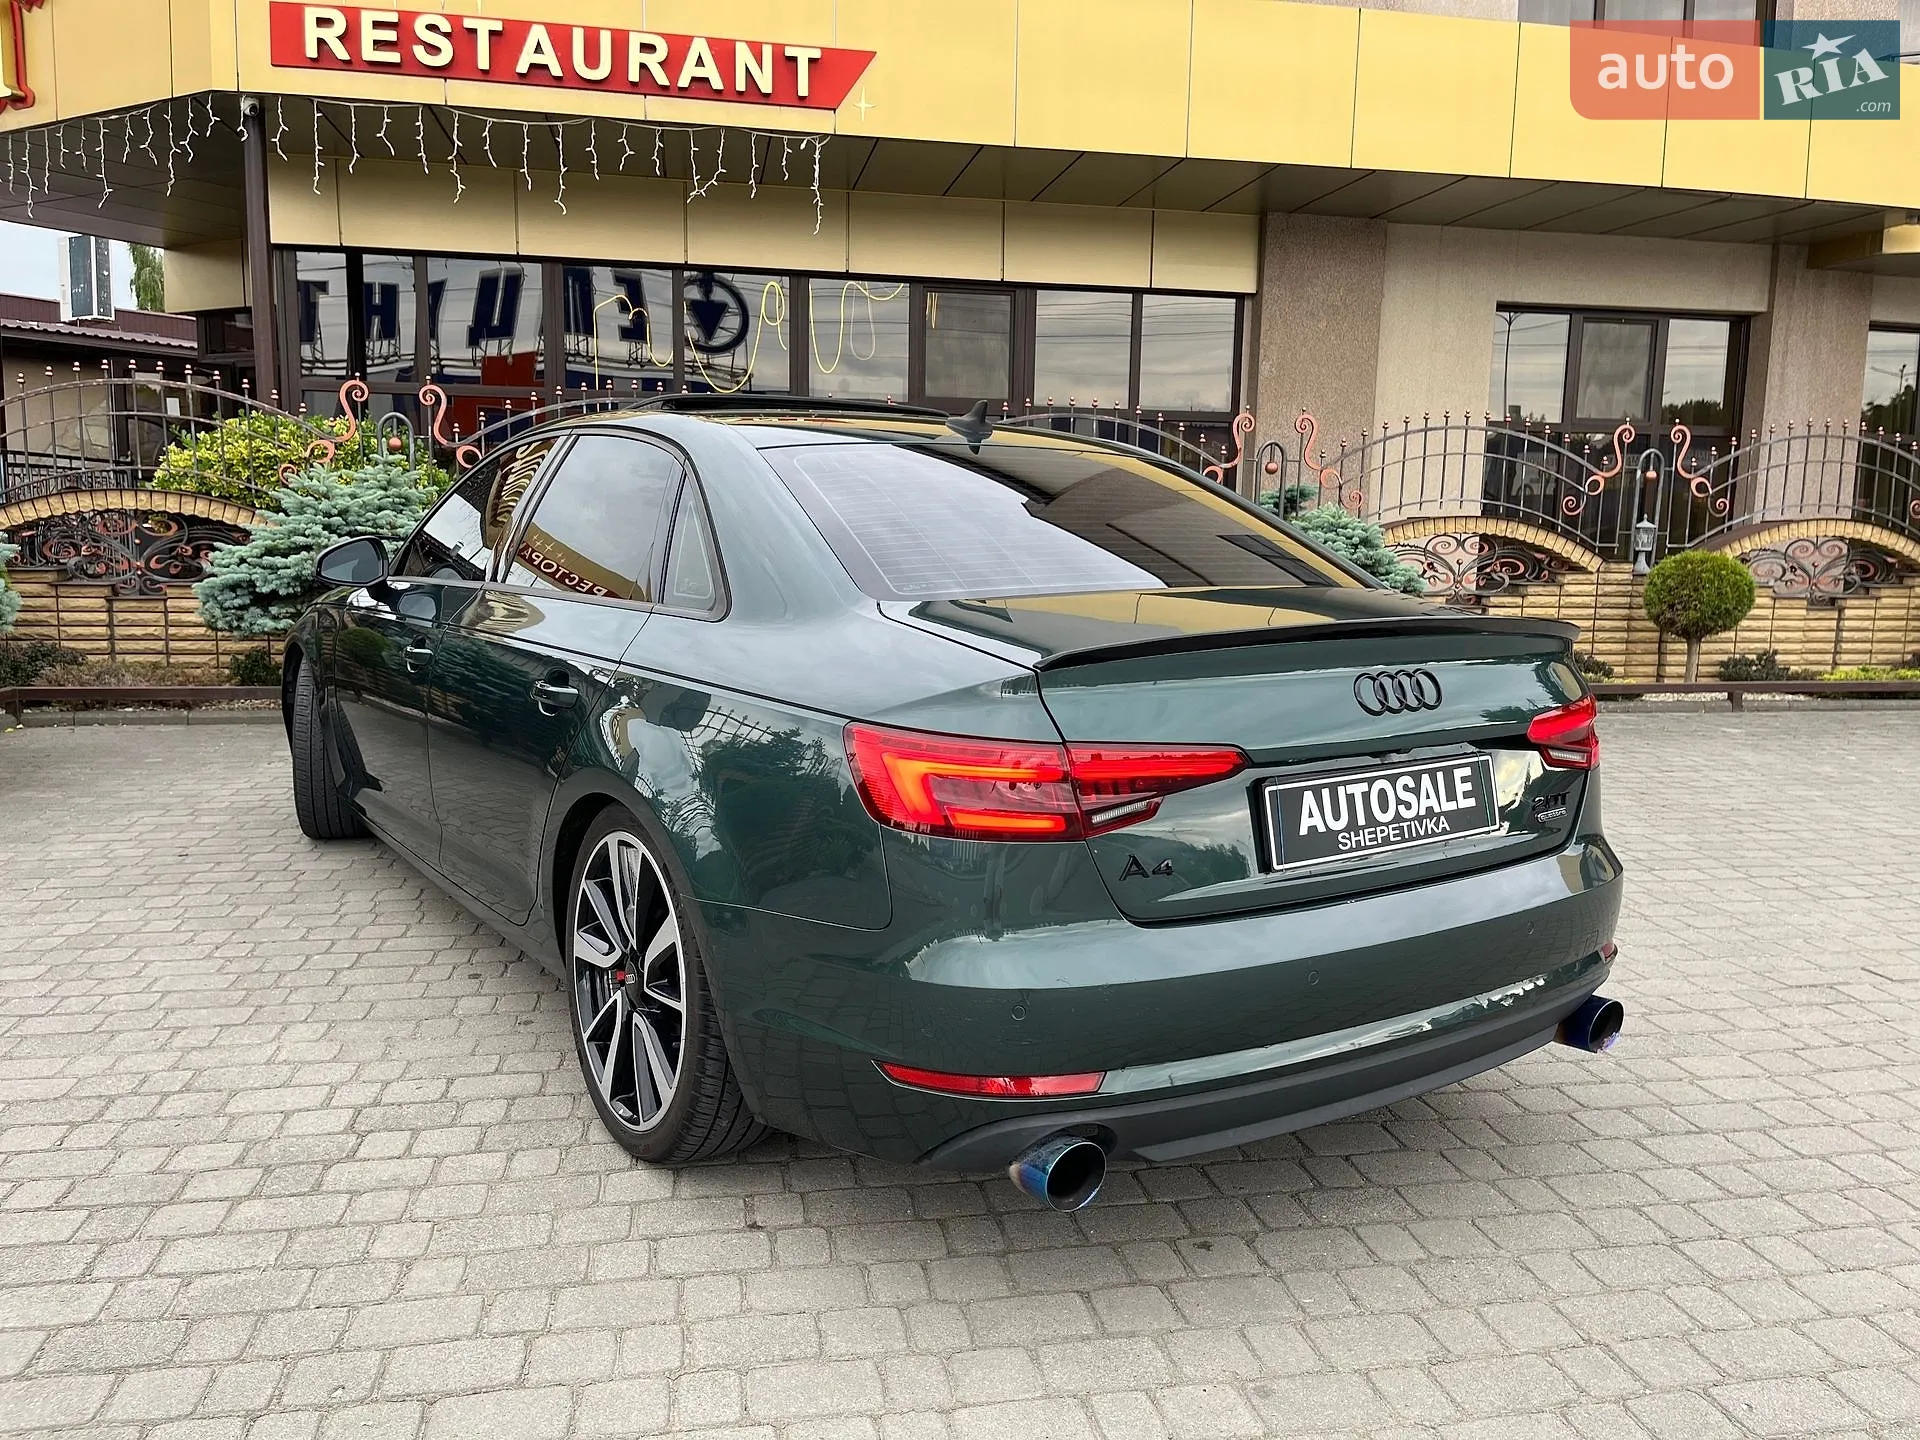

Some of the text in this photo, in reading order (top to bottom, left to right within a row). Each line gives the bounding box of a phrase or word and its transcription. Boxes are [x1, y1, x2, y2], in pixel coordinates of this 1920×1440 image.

[303, 6, 823, 98] RESTAURANT
[1299, 766, 1477, 836] AUTOSALE
[1338, 816, 1451, 851] SHEPETIVKA
[1119, 854, 1174, 881] A4
